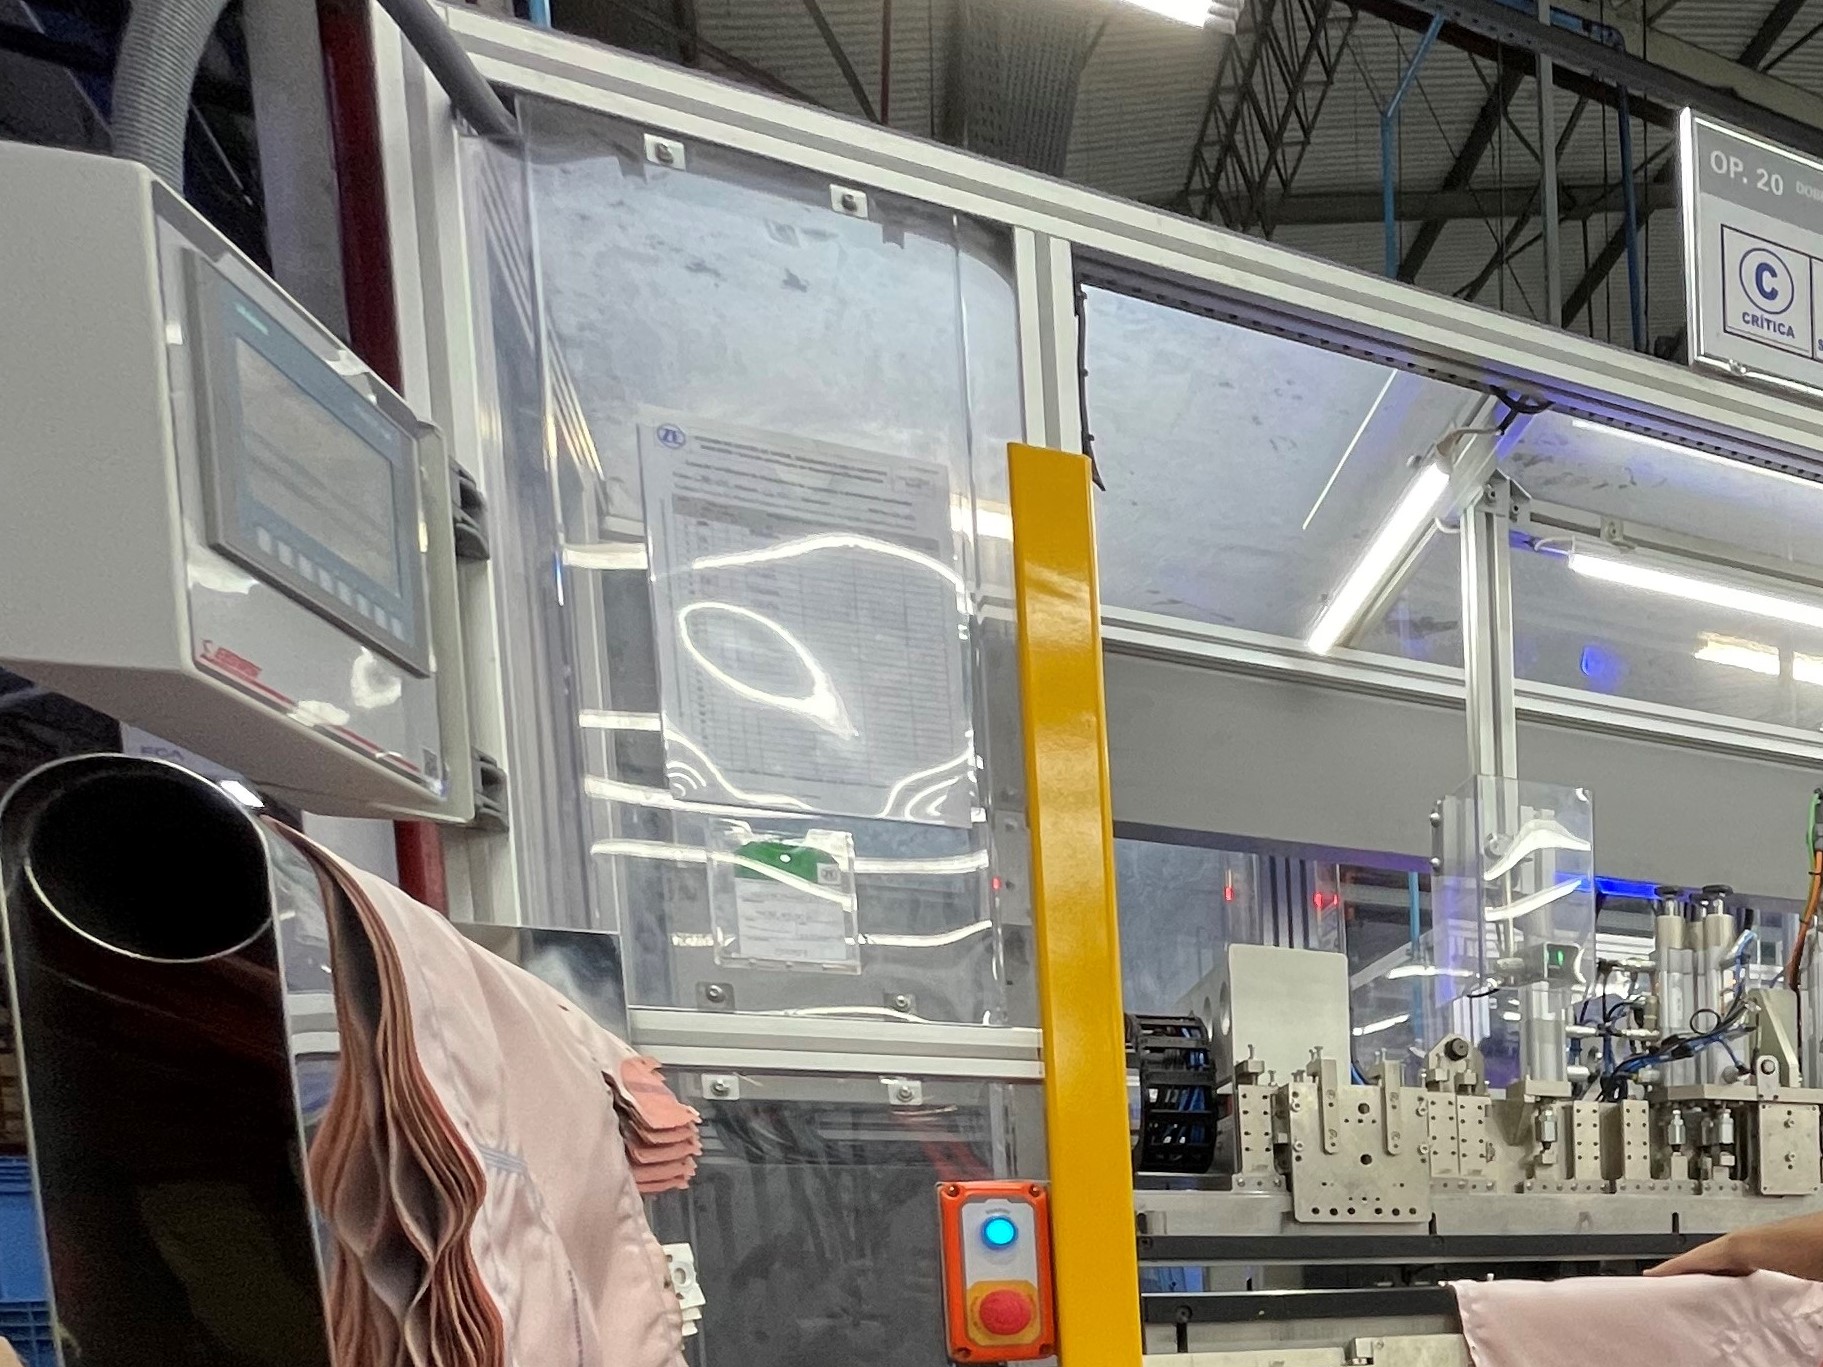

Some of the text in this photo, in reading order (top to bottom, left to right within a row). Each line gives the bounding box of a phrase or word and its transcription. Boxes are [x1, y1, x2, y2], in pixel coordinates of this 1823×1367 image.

[1710, 150, 1784, 196] OP. 20
[1755, 262, 1778, 300] C
[1742, 311, 1795, 339] CRÍTICA
